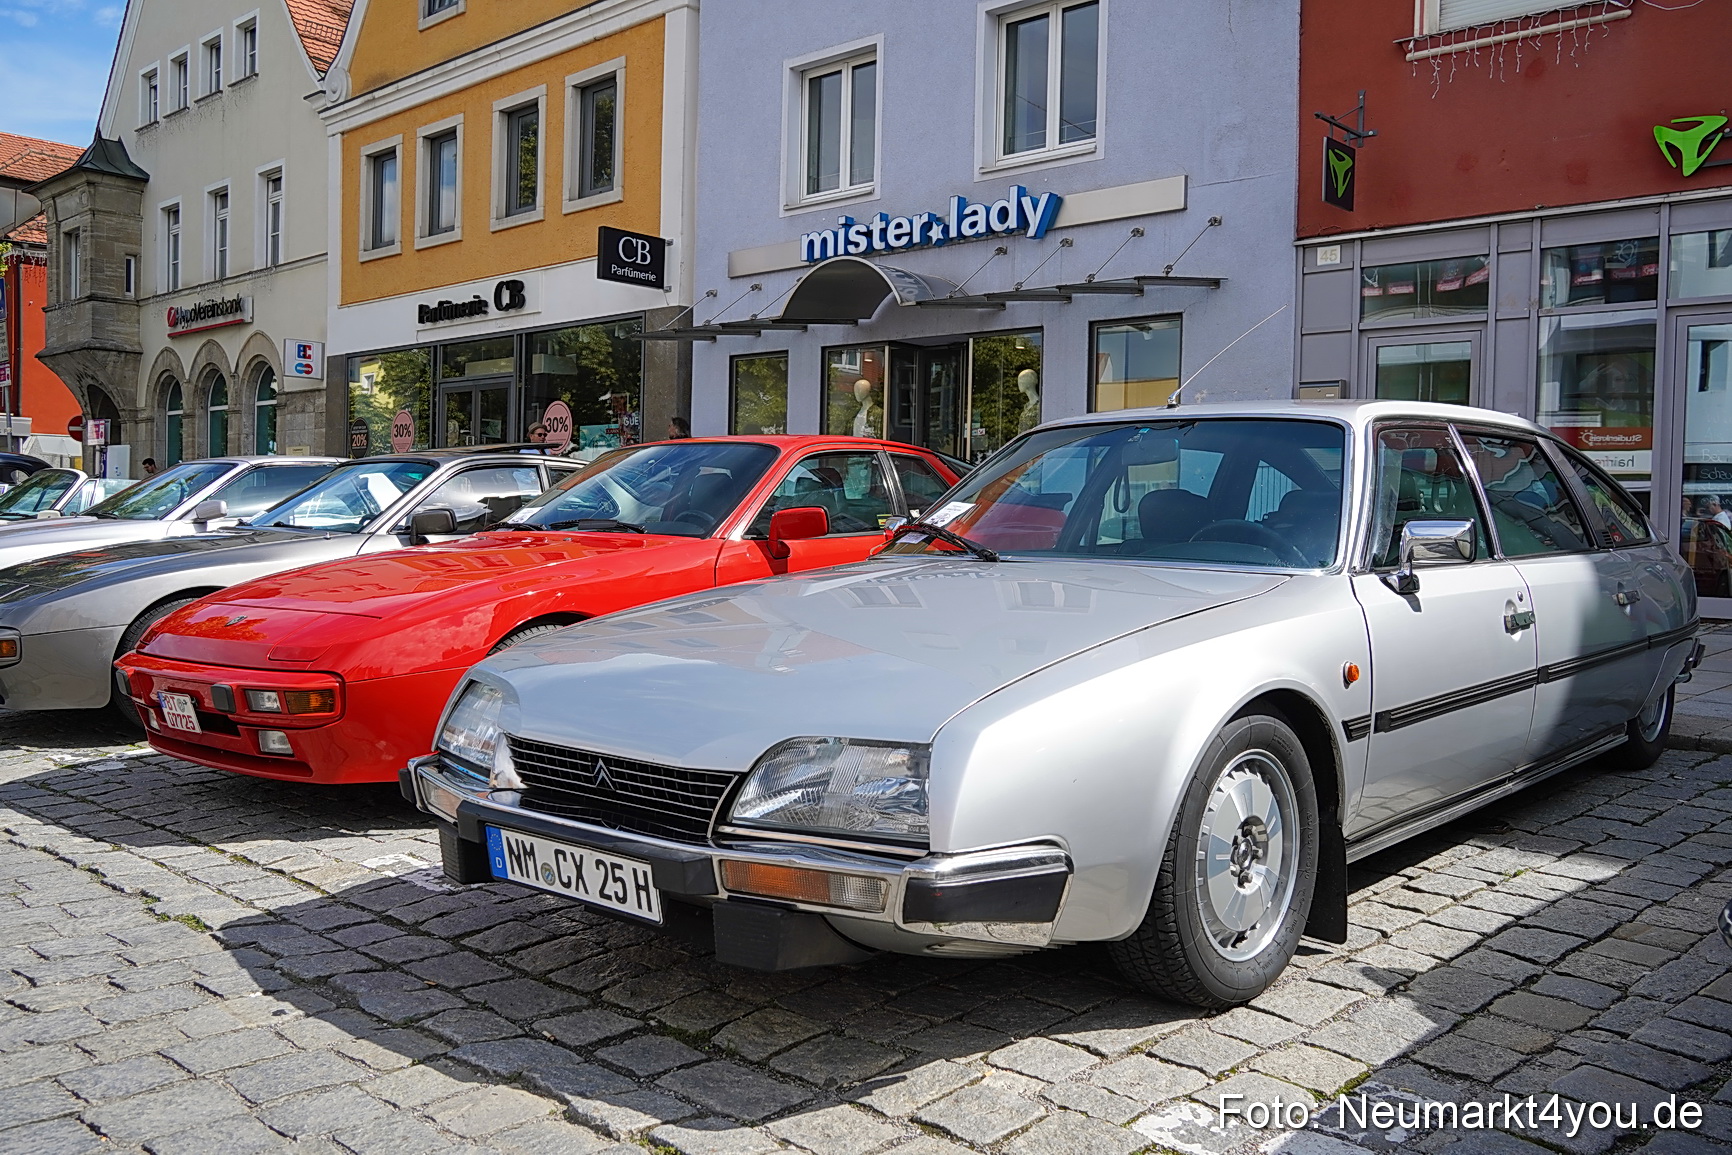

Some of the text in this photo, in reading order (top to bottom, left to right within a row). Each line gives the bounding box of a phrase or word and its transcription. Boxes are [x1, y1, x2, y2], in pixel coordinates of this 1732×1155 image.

[800, 184, 1063, 263] mister lady
[618, 236, 651, 265] CB
[1320, 249, 1338, 262] 45
[611, 264, 657, 282] Parfümerie
[418, 279, 526, 325] Parfümerie CB
[176, 293, 243, 330] HypoVereinsbank
[393, 423, 412, 439] 30%
[545, 416, 569, 434] 30%
[351, 433, 368, 448] 20%
[495, 856, 503, 869] D
[505, 836, 540, 882] NM
[553, 848, 590, 895] CX
